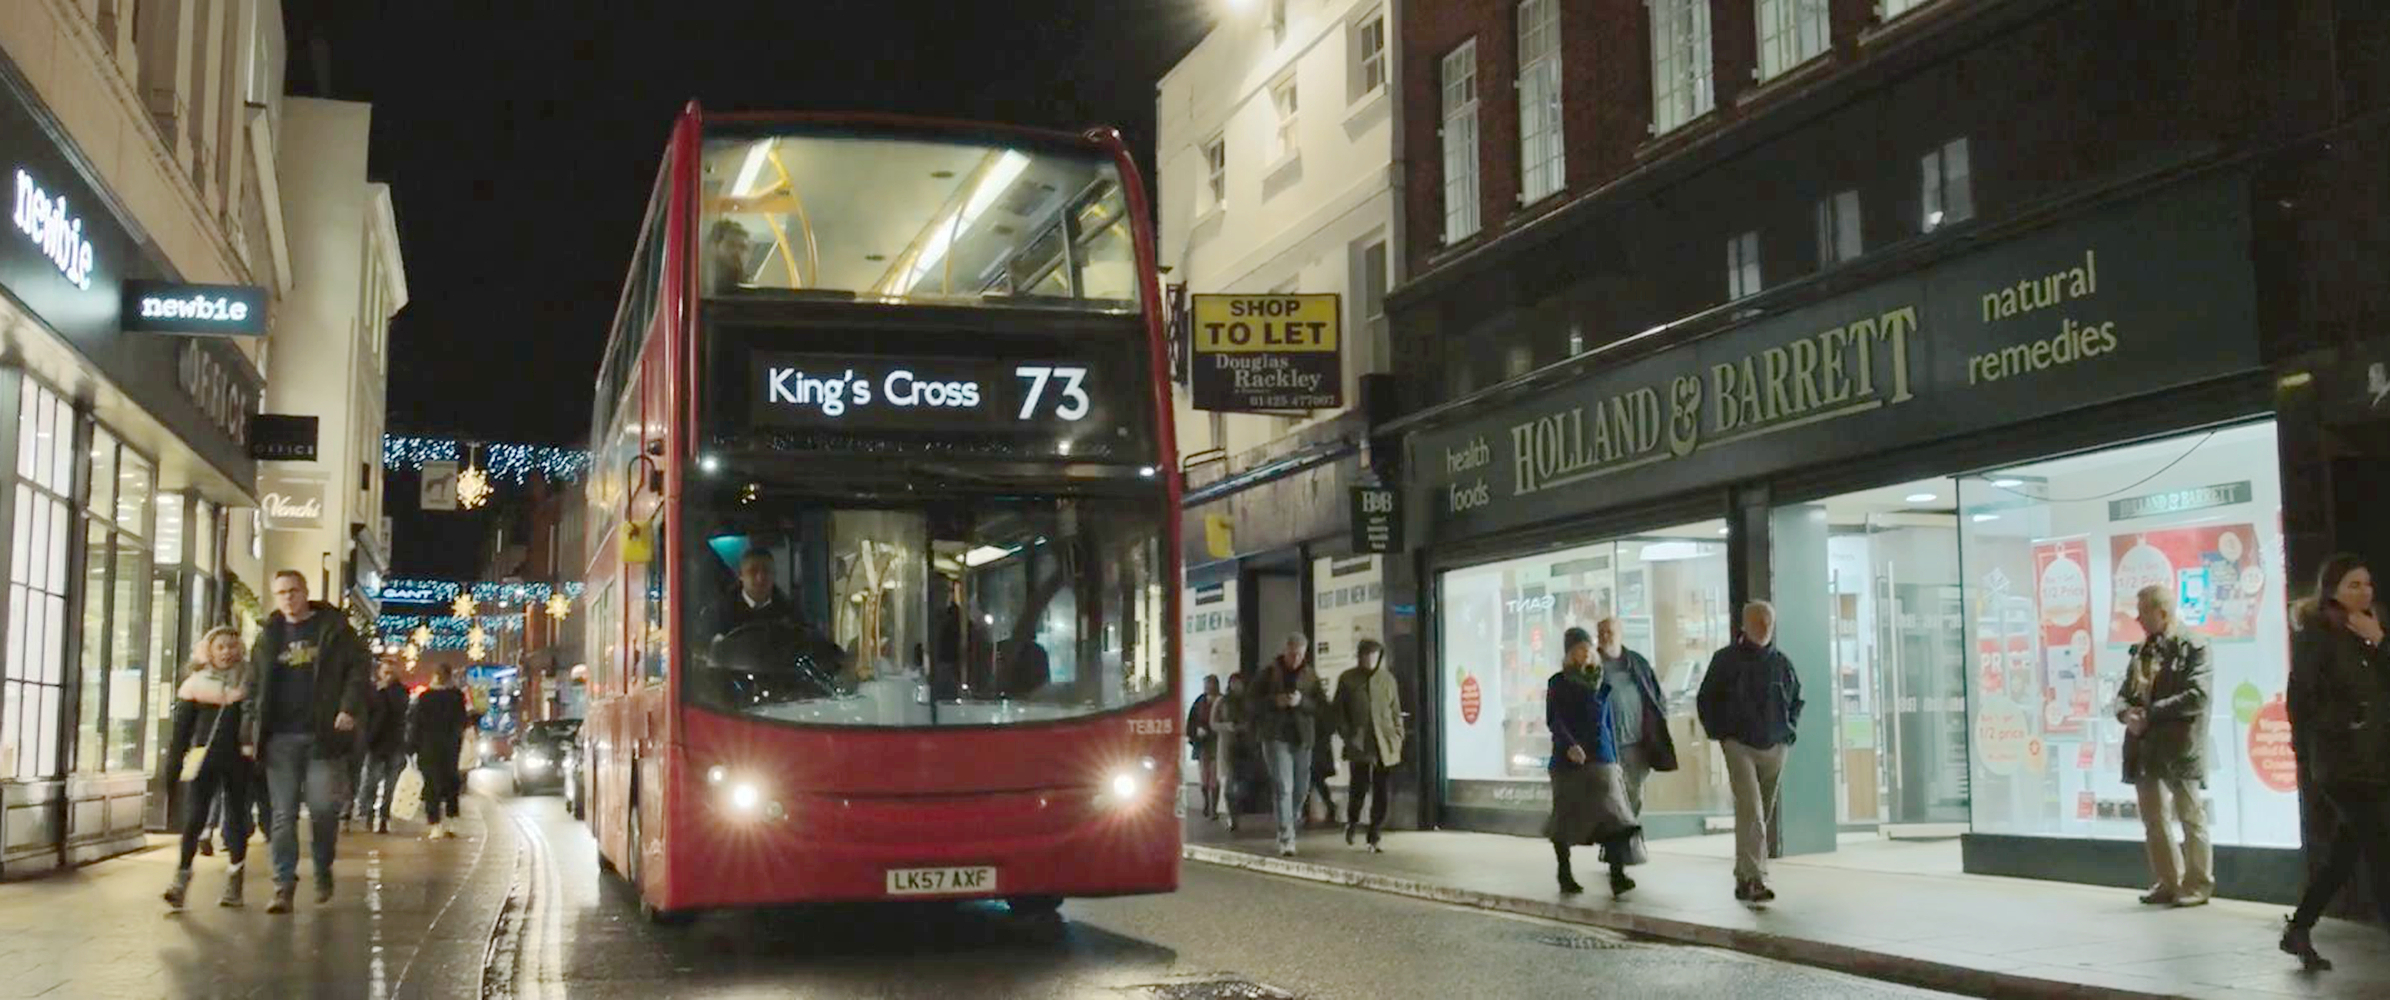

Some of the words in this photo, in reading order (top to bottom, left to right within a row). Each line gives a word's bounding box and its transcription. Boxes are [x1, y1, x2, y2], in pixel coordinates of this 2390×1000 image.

[14, 168, 93, 290] newbie
[1982, 250, 2097, 322] natural
[140, 295, 248, 321] newbie
[1231, 299, 1300, 317] SHOP
[1205, 322, 1251, 345] TO
[1264, 322, 1327, 345] LET
[1215, 353, 1290, 371] Douglas
[1968, 319, 2117, 386] remedies
[1234, 368, 1322, 392] Rackley
[768, 367, 872, 417] King's
[883, 370, 981, 408] Cross
[1015, 366, 1090, 421] 73
[1511, 385, 1660, 496] HOLLAND
[1667, 374, 1702, 457] &
[1711, 305, 1918, 433] BARRETT
[1446, 435, 1490, 475] health
[262, 492, 321, 518] Venchi
[1446, 480, 1491, 513] foods
[383, 588, 433, 599] GANT
[894, 871, 945, 889] LK57
[952, 869, 988, 888] AXF
